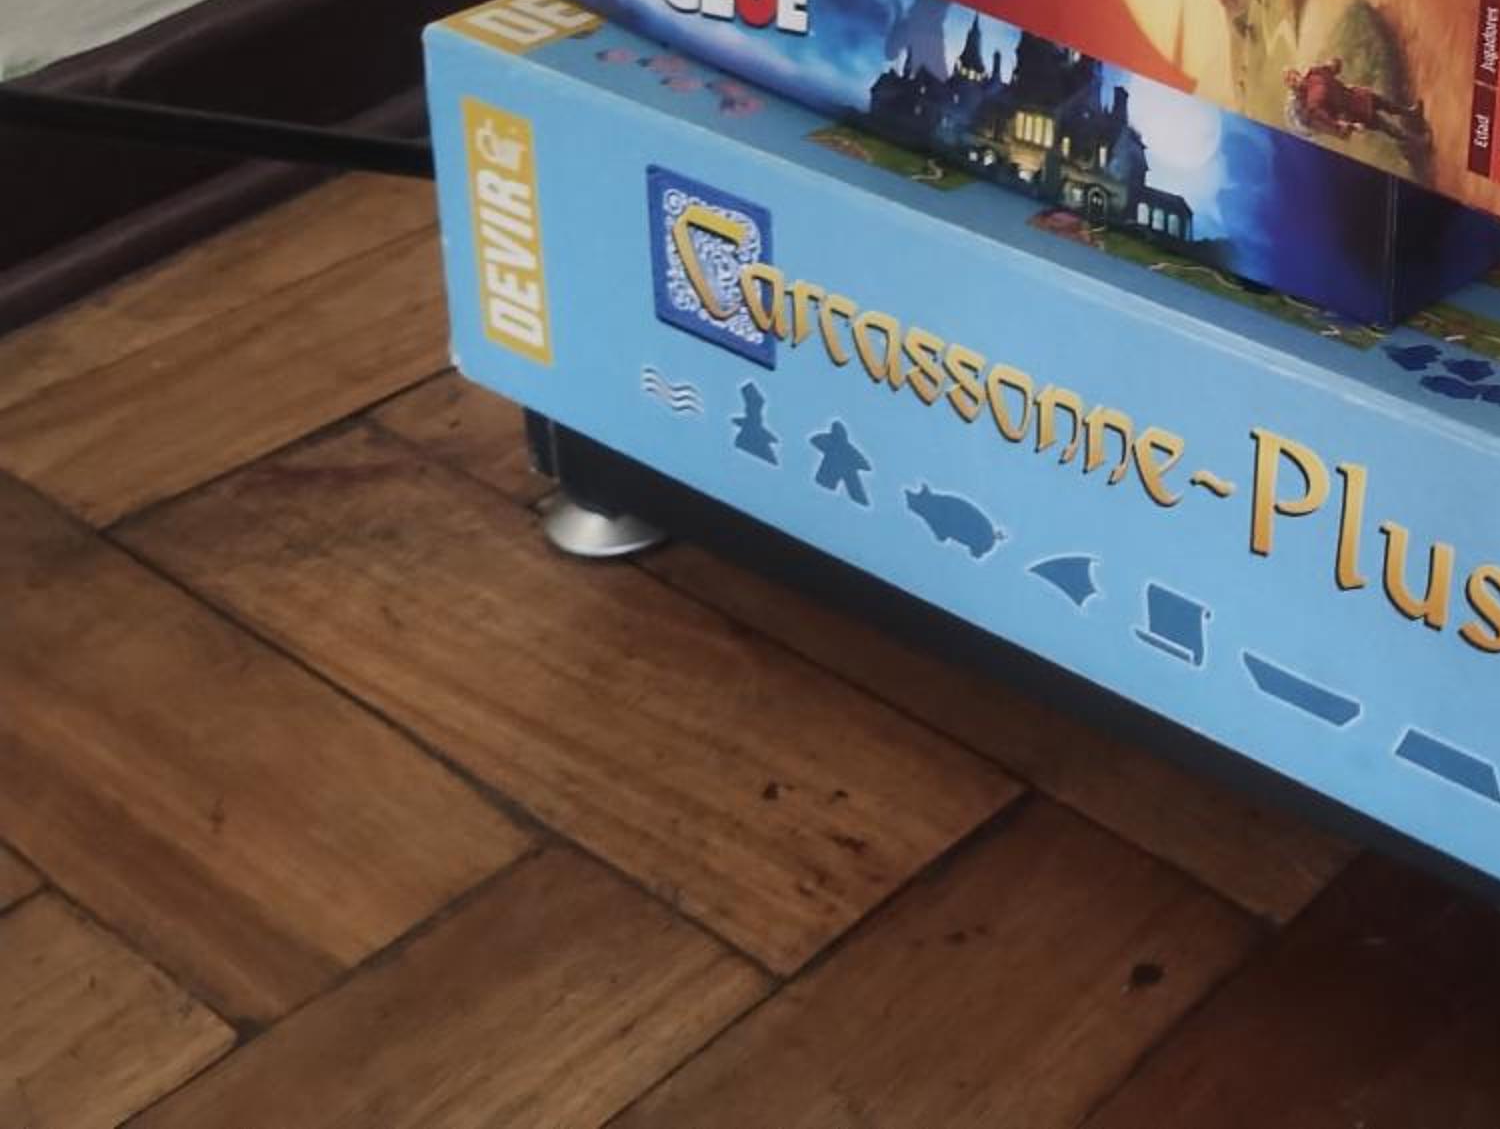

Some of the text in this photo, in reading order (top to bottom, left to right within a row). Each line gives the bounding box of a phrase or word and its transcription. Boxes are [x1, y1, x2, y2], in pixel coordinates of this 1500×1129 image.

[1473, 114, 1491, 149] Edad
[1484, 6, 1500, 73] Jugadores
[476, 169, 545, 348] DEVIR
